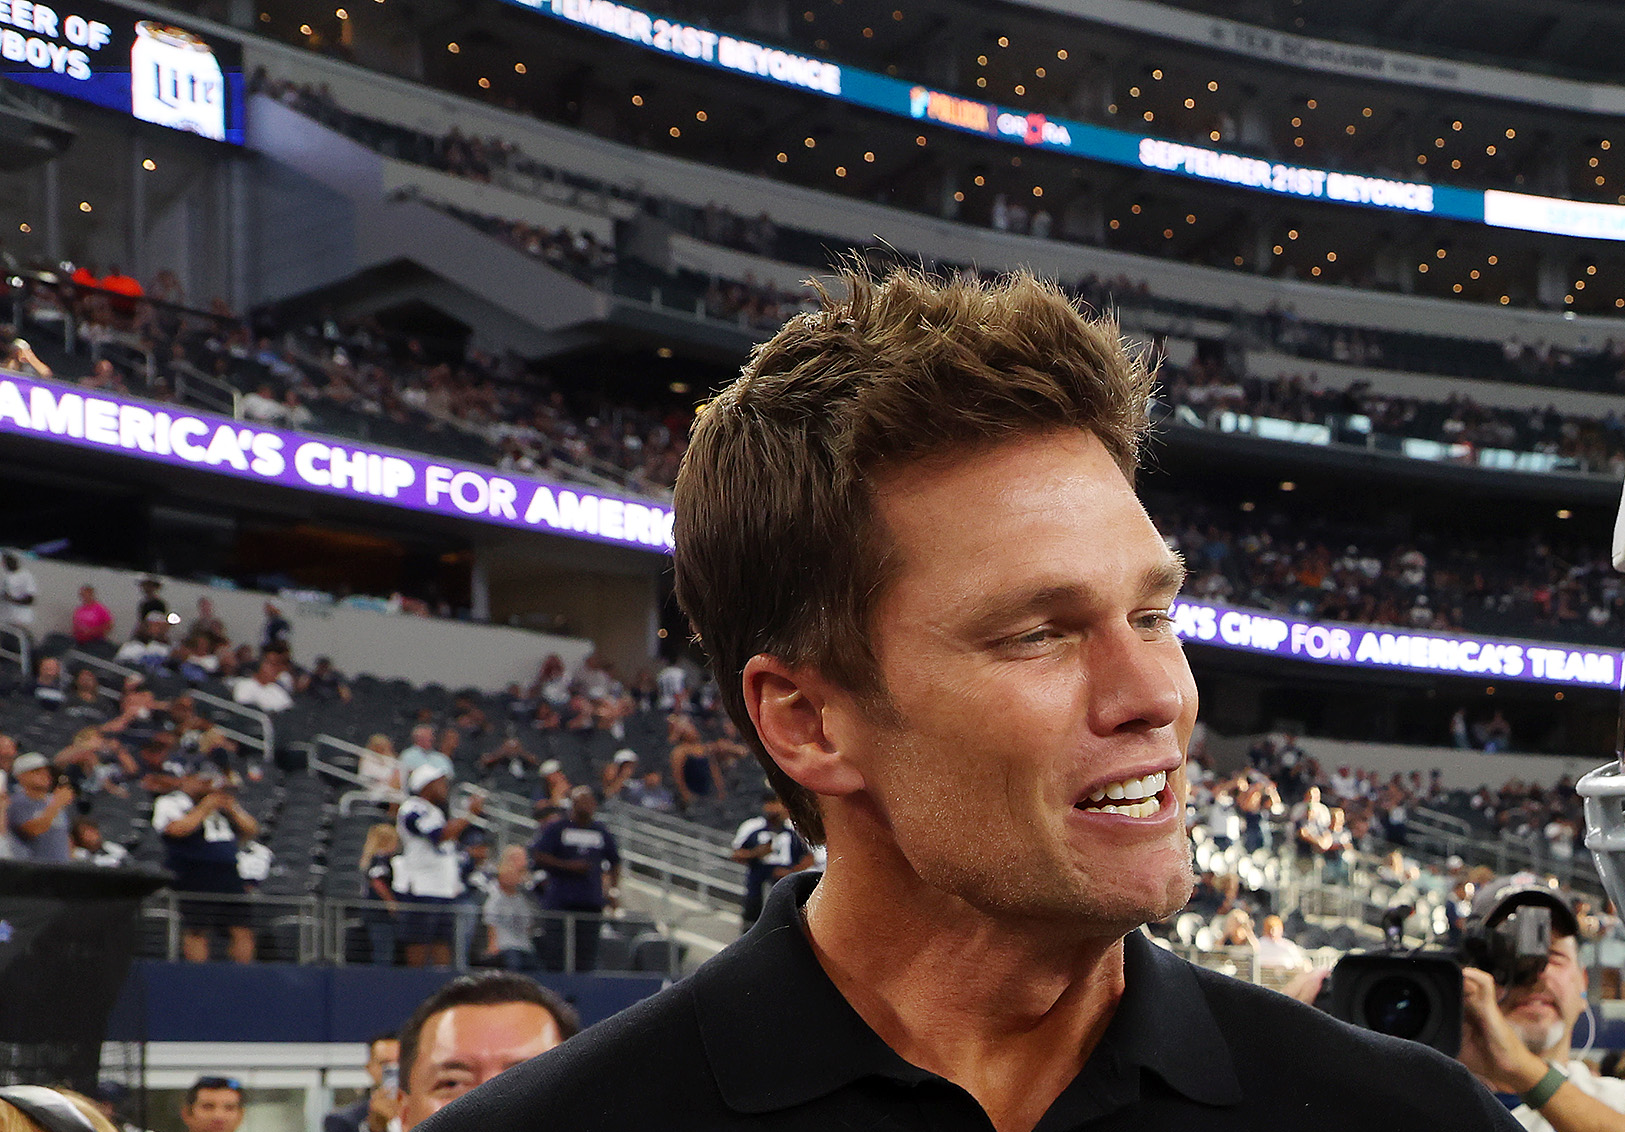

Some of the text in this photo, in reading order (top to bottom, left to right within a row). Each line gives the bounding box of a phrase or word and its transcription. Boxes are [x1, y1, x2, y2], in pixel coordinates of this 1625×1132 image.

[0, 28, 92, 81] BOYS
[64, 15, 112, 51] OF
[653, 19, 718, 61] 21ST
[719, 36, 842, 95] BEYONCE
[1139, 138, 1434, 212] SEPTEMBER 21ST BEYONCE
[0, 380, 286, 477] AMERICA'S
[294, 442, 415, 498] CHIP
[425, 466, 518, 520] FOR
[1219, 611, 1289, 651] CHIP
[1291, 623, 1351, 661] FOR
[1355, 632, 1524, 677] AMERICA'S
[1527, 648, 1615, 685] TEAM
